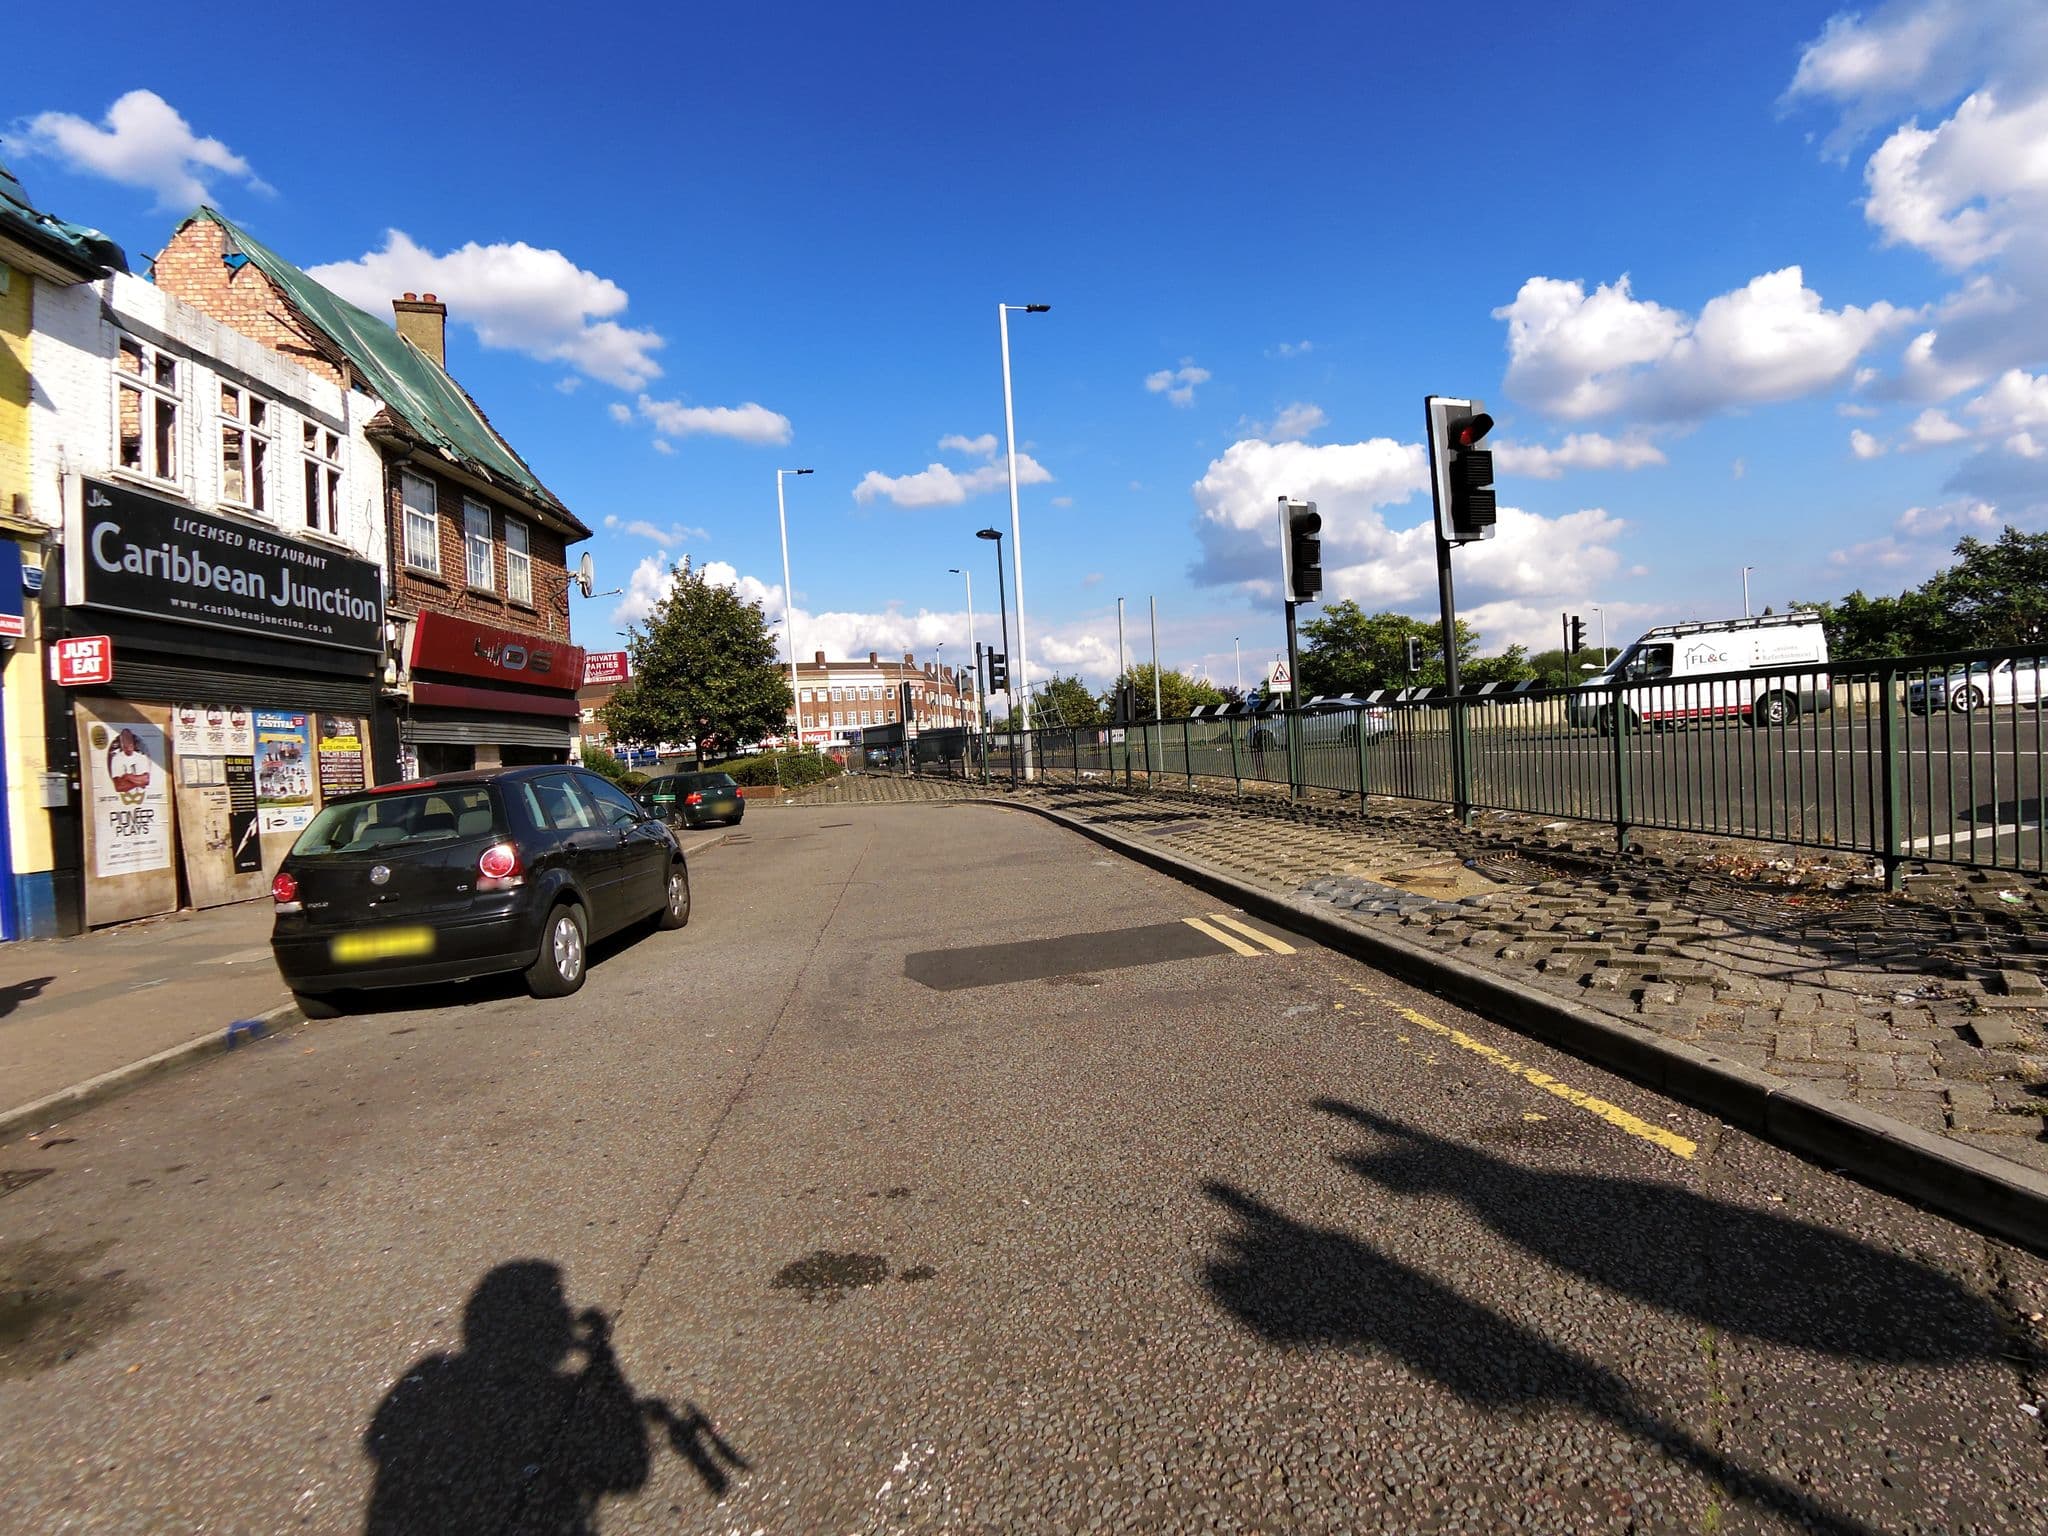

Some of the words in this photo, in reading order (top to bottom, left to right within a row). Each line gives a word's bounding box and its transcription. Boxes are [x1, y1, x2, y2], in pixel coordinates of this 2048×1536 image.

[173, 516, 244, 548] LICENSED
[247, 537, 328, 571] RESTAURANT
[91, 521, 266, 600] Caribbean
[270, 567, 378, 623] Junction
[170, 597, 334, 635] www.caribbeanjunction.co.uk
[62, 640, 103, 659] JUST
[586, 654, 618, 663] PRIVATE
[1691, 652, 1728, 665] FL&C
[71, 657, 103, 675] EAT
[586, 661, 619, 671] PARTIES
[115, 824, 150, 838] PLAYS
